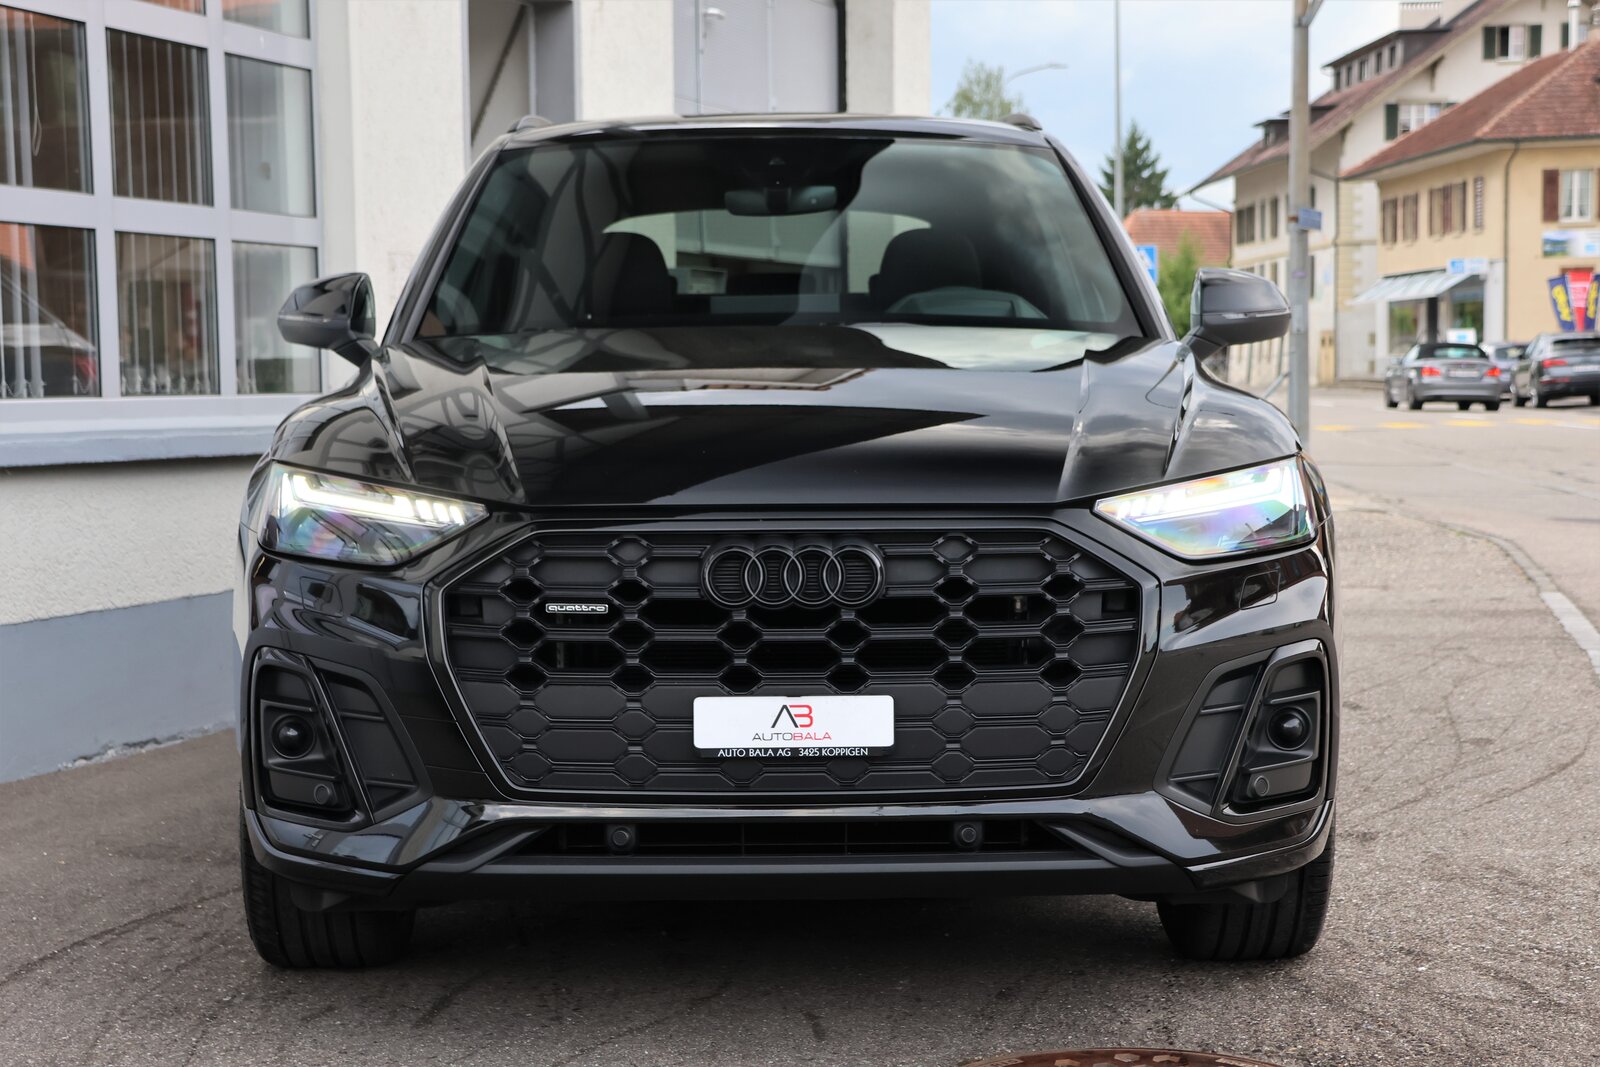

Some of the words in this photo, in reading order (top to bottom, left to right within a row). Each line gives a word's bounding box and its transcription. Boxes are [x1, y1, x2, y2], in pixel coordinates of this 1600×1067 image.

[548, 604, 606, 612] quattro
[771, 704, 814, 729] AB
[752, 731, 832, 741] AUTOBALA
[718, 748, 746, 757] AUTO
[749, 748, 775, 757] BALA
[777, 748, 791, 757] AG
[798, 748, 820, 757] 3425
[822, 747, 869, 757] KOPPIGEN
